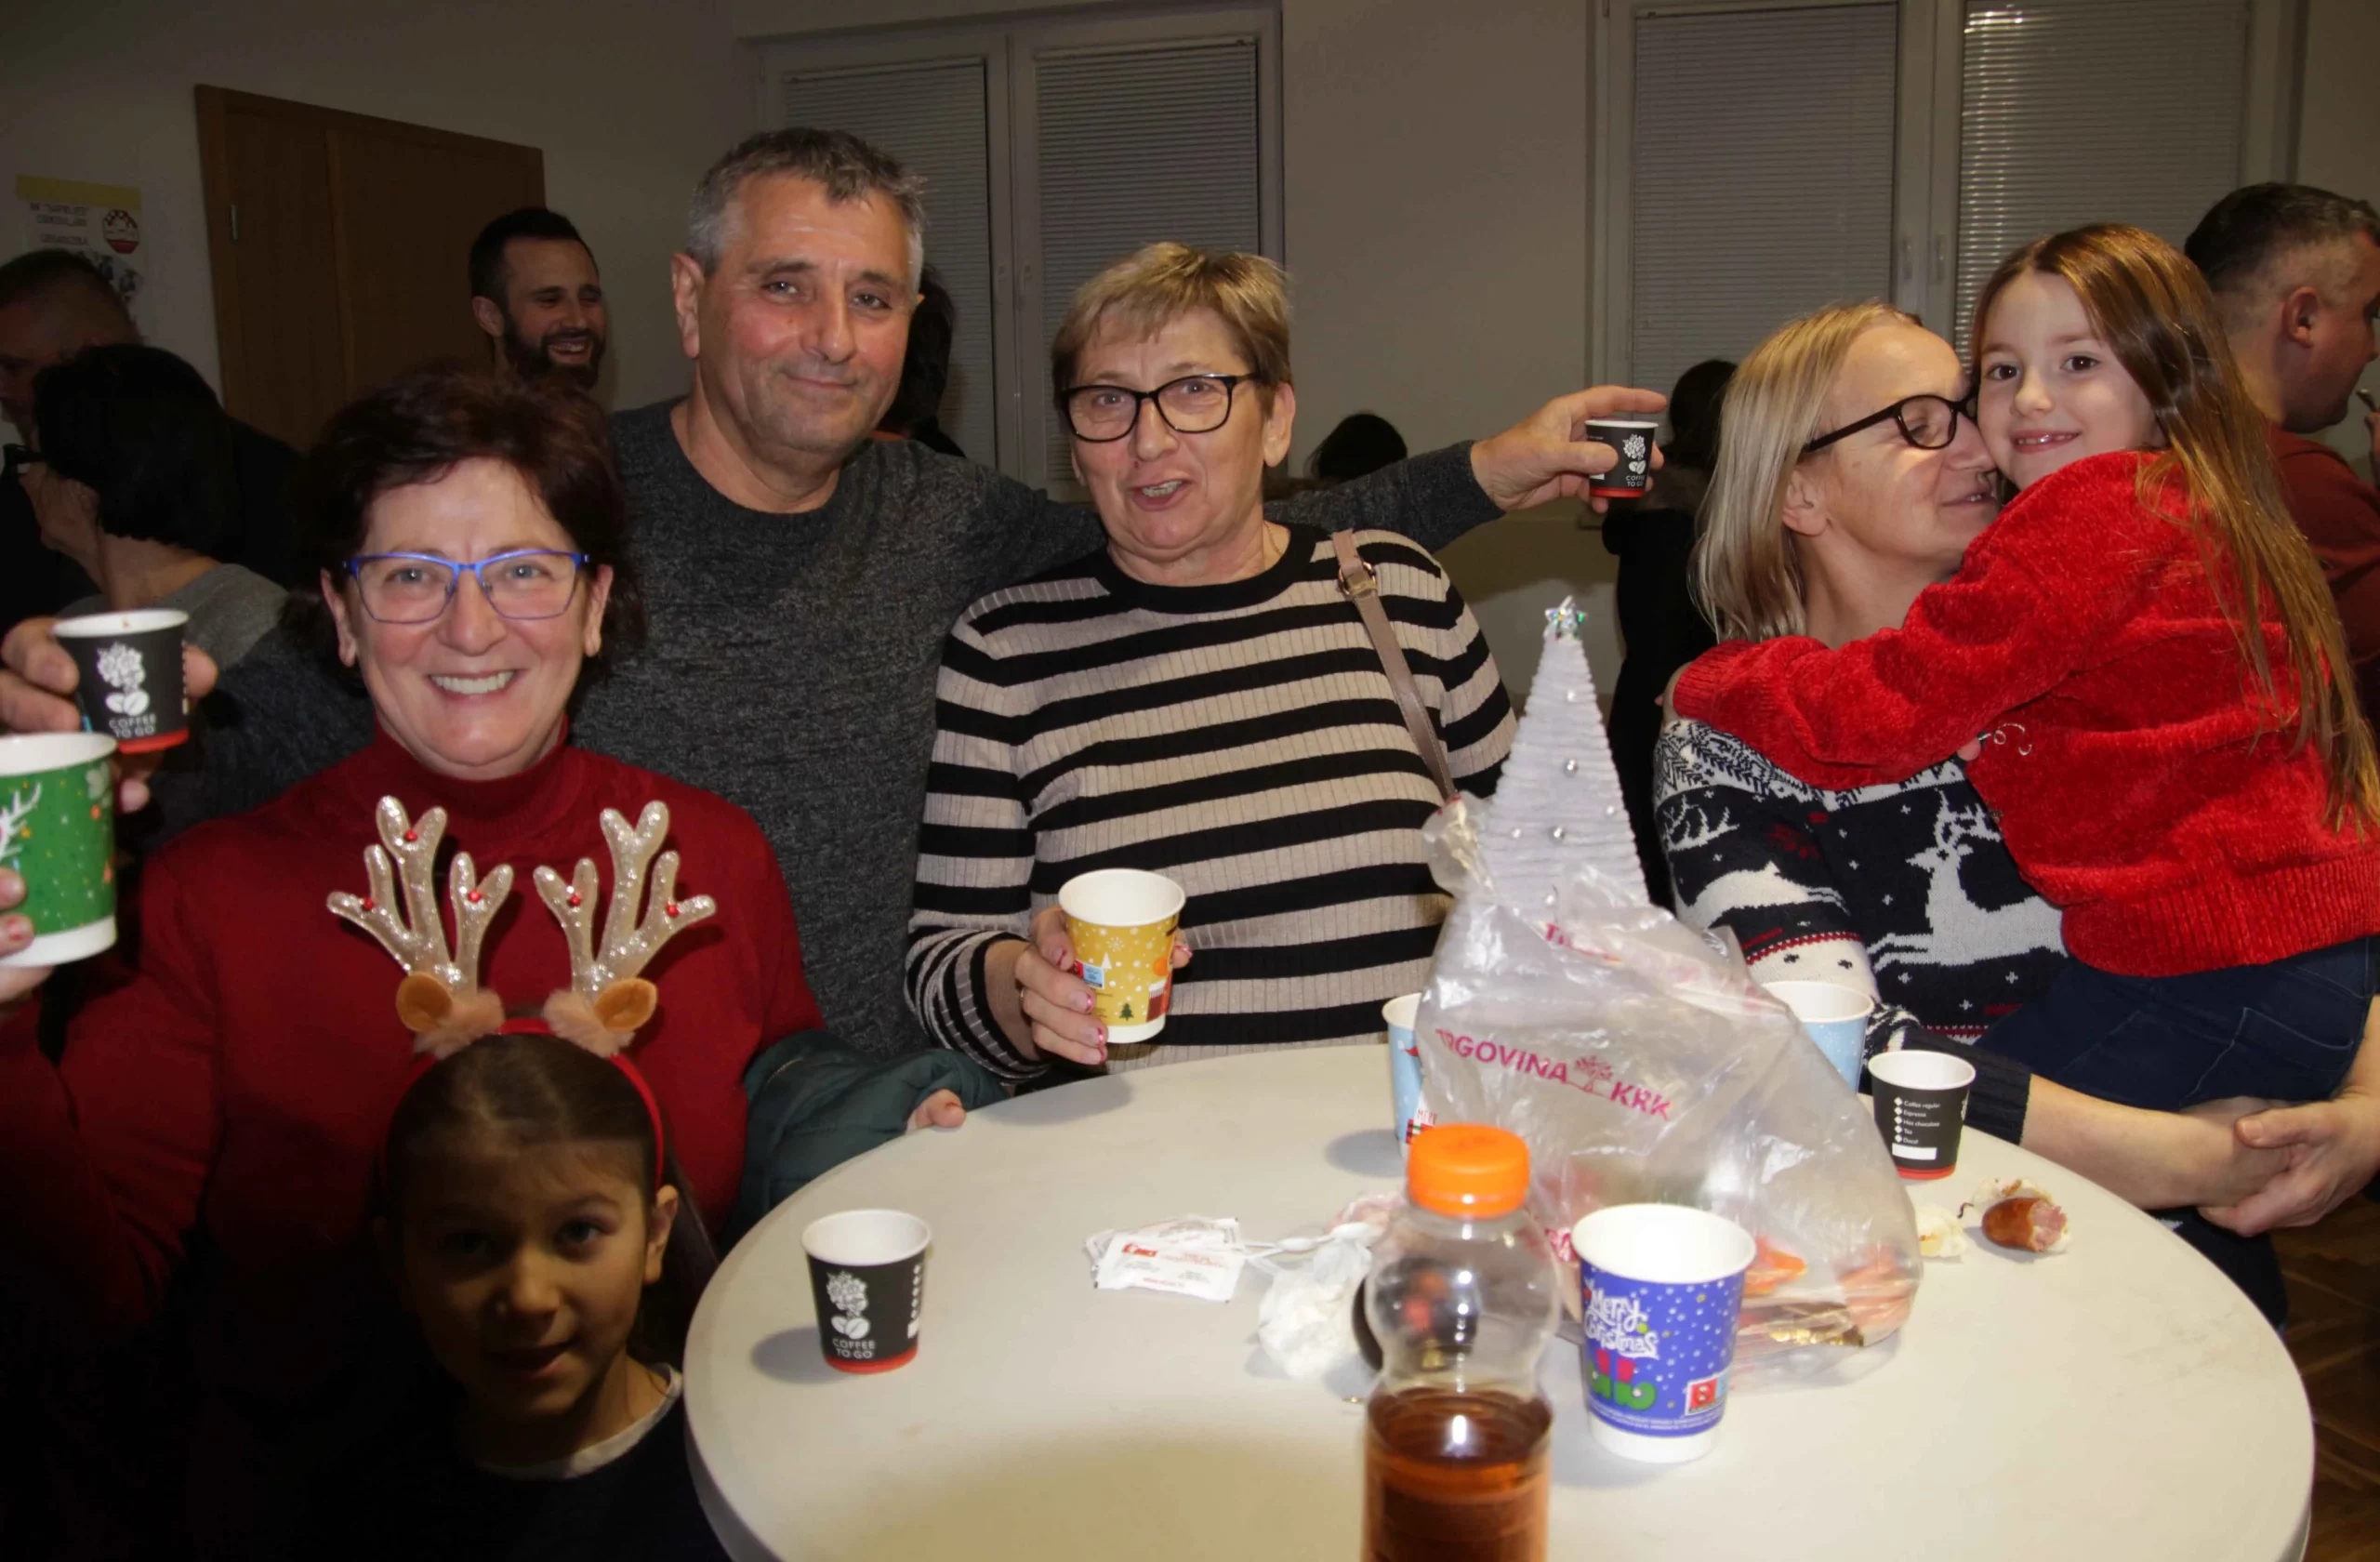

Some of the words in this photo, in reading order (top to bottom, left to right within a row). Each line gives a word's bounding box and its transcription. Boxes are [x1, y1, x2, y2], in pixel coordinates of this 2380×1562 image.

[109, 713, 156, 730] COFFEE
[113, 728, 131, 739] TO
[134, 724, 154, 736] GO
[1610, 1081, 1672, 1120] KRK
[1903, 1100, 1922, 1108] Coffee
[1903, 1109, 1926, 1118] Espresso
[1589, 1288, 1648, 1333] Merry
[1584, 1310, 1660, 1360] Christmas
[832, 1338, 875, 1350] COFFEE
[837, 1348, 851, 1358] TO
[853, 1350, 873, 1359] GO
